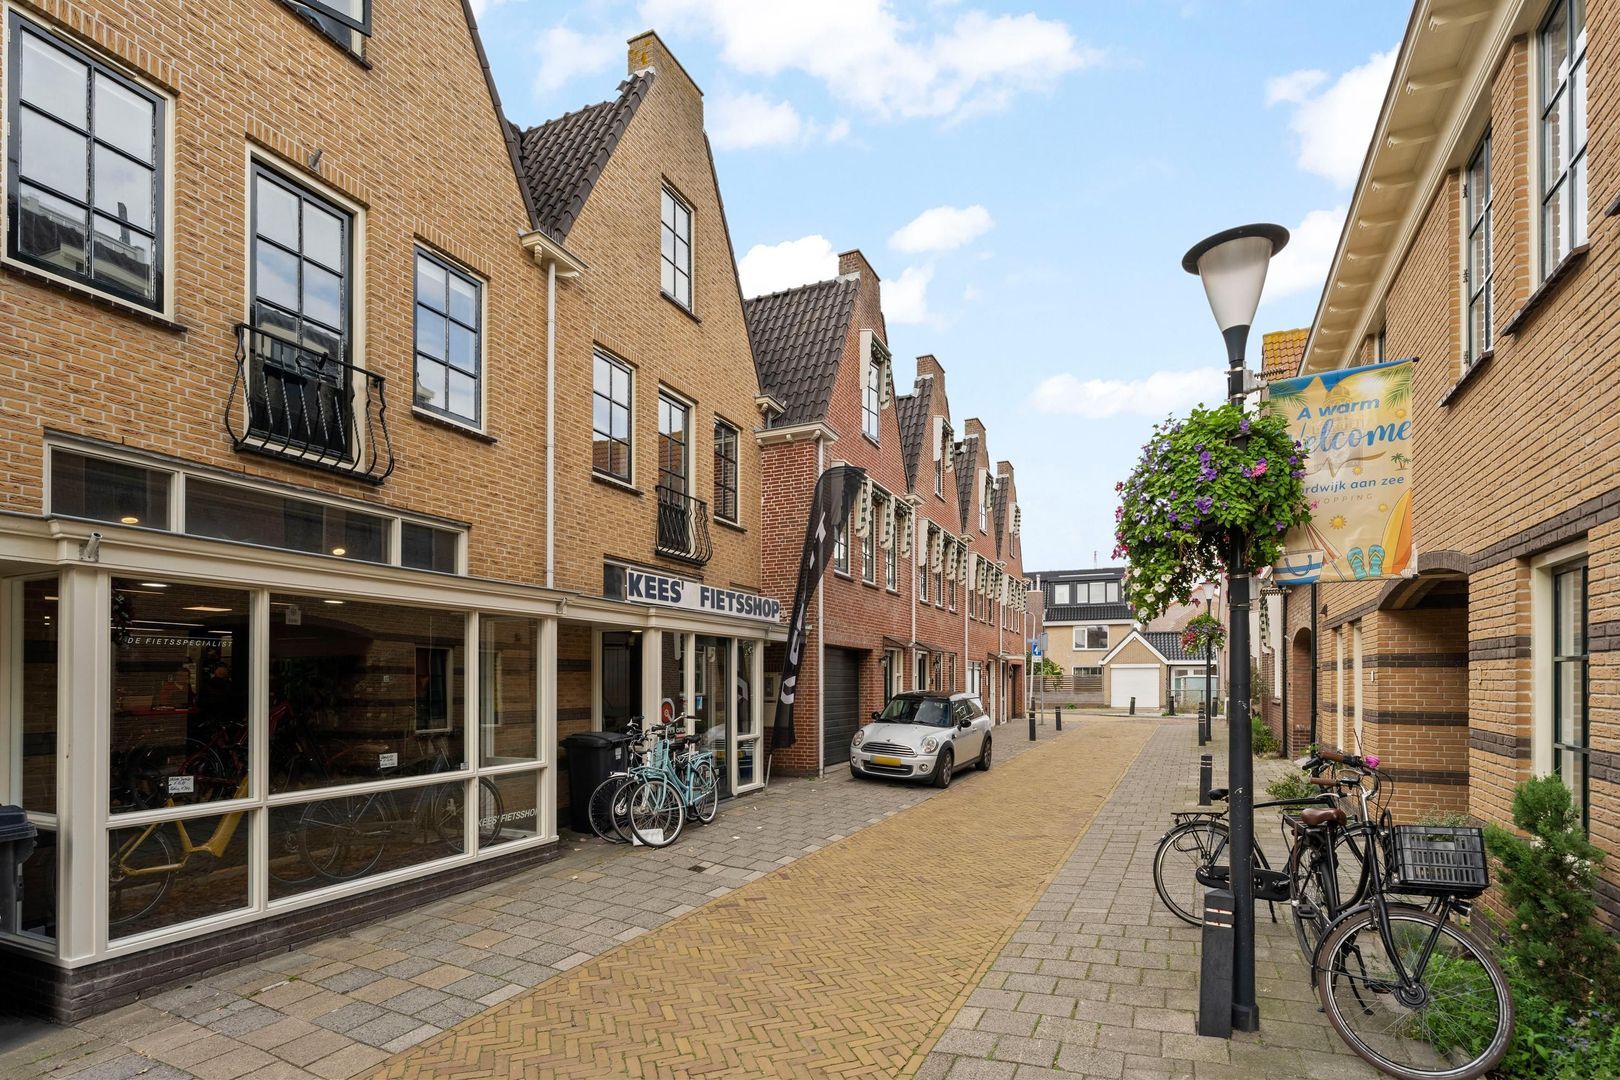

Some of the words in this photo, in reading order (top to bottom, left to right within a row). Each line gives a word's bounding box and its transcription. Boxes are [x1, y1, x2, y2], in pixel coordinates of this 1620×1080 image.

[1297, 407, 1312, 420] A
[1319, 399, 1380, 417] warm
[1350, 480, 1376, 489] aan
[1381, 476, 1405, 486] zee
[628, 572, 685, 603] KEES'
[700, 586, 780, 618] FIETSSHOP
[145, 638, 233, 647] FIETSSPECIALIST
